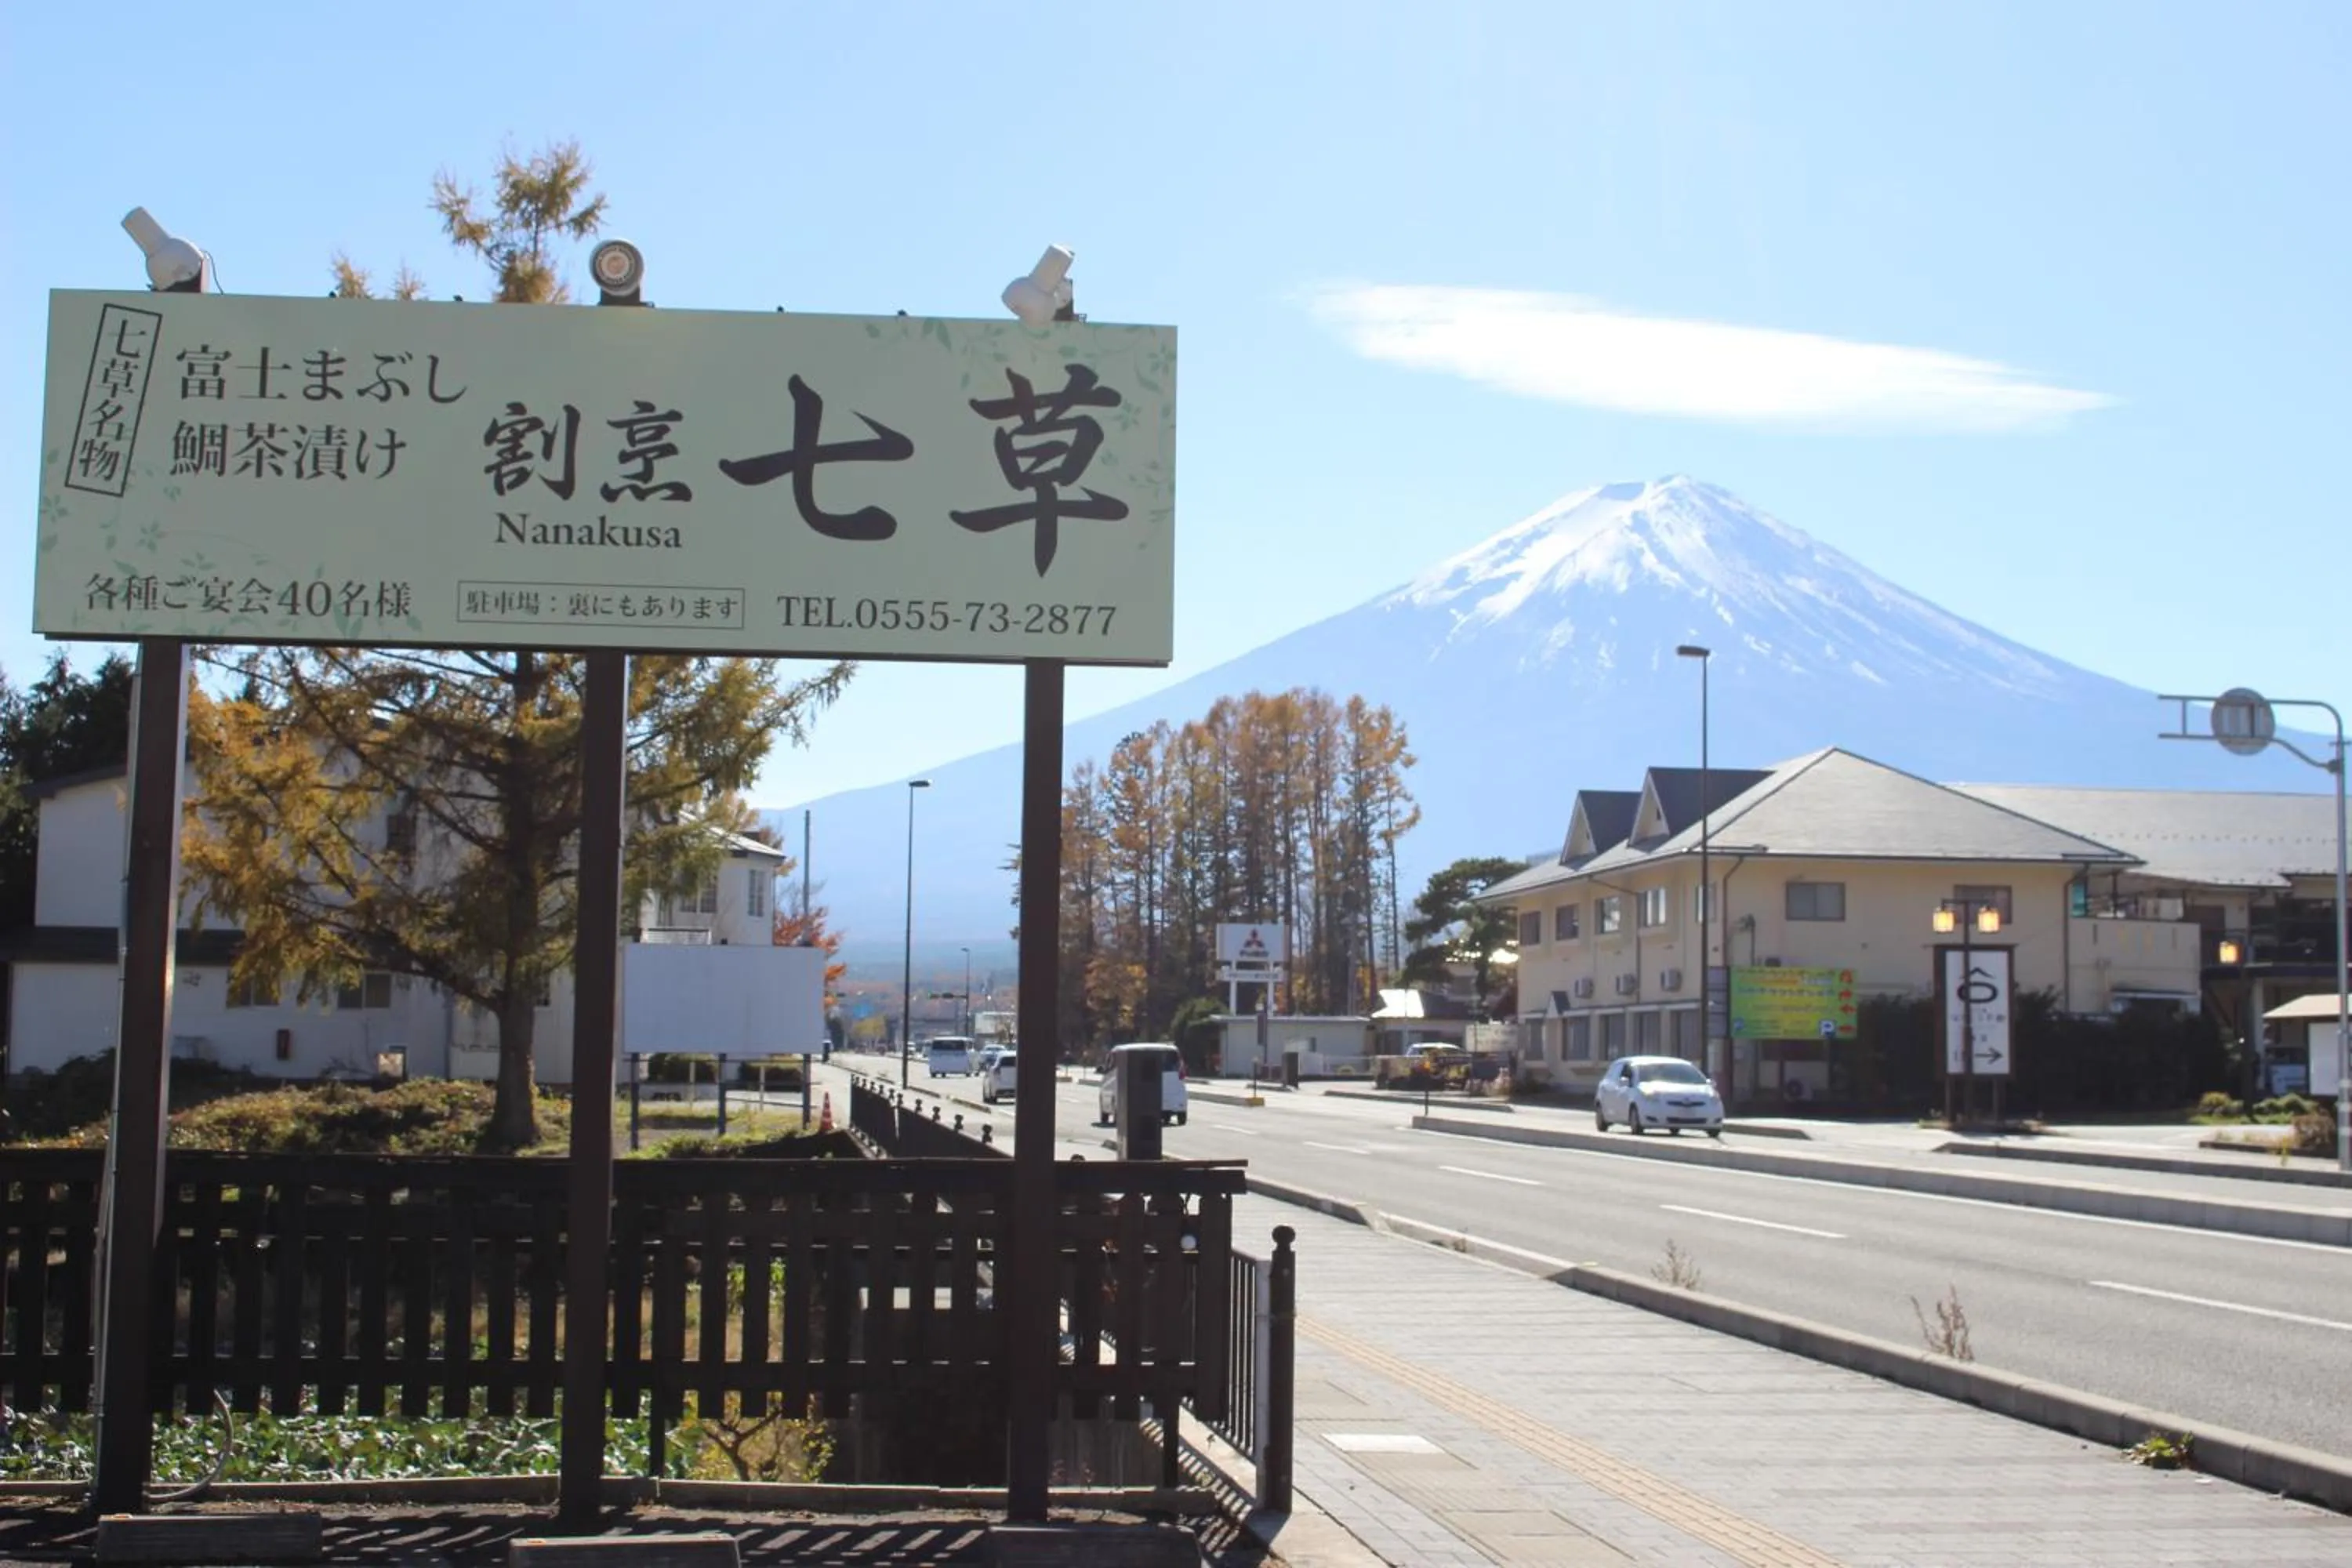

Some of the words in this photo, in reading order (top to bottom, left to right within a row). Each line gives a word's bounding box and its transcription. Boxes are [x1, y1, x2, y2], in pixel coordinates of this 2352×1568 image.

[79, 319, 147, 481] 七草名物
[176, 344, 468, 404] 富士まぶし
[170, 420, 408, 481] 鯛茶漬け
[495, 512, 682, 549] Nanakusa
